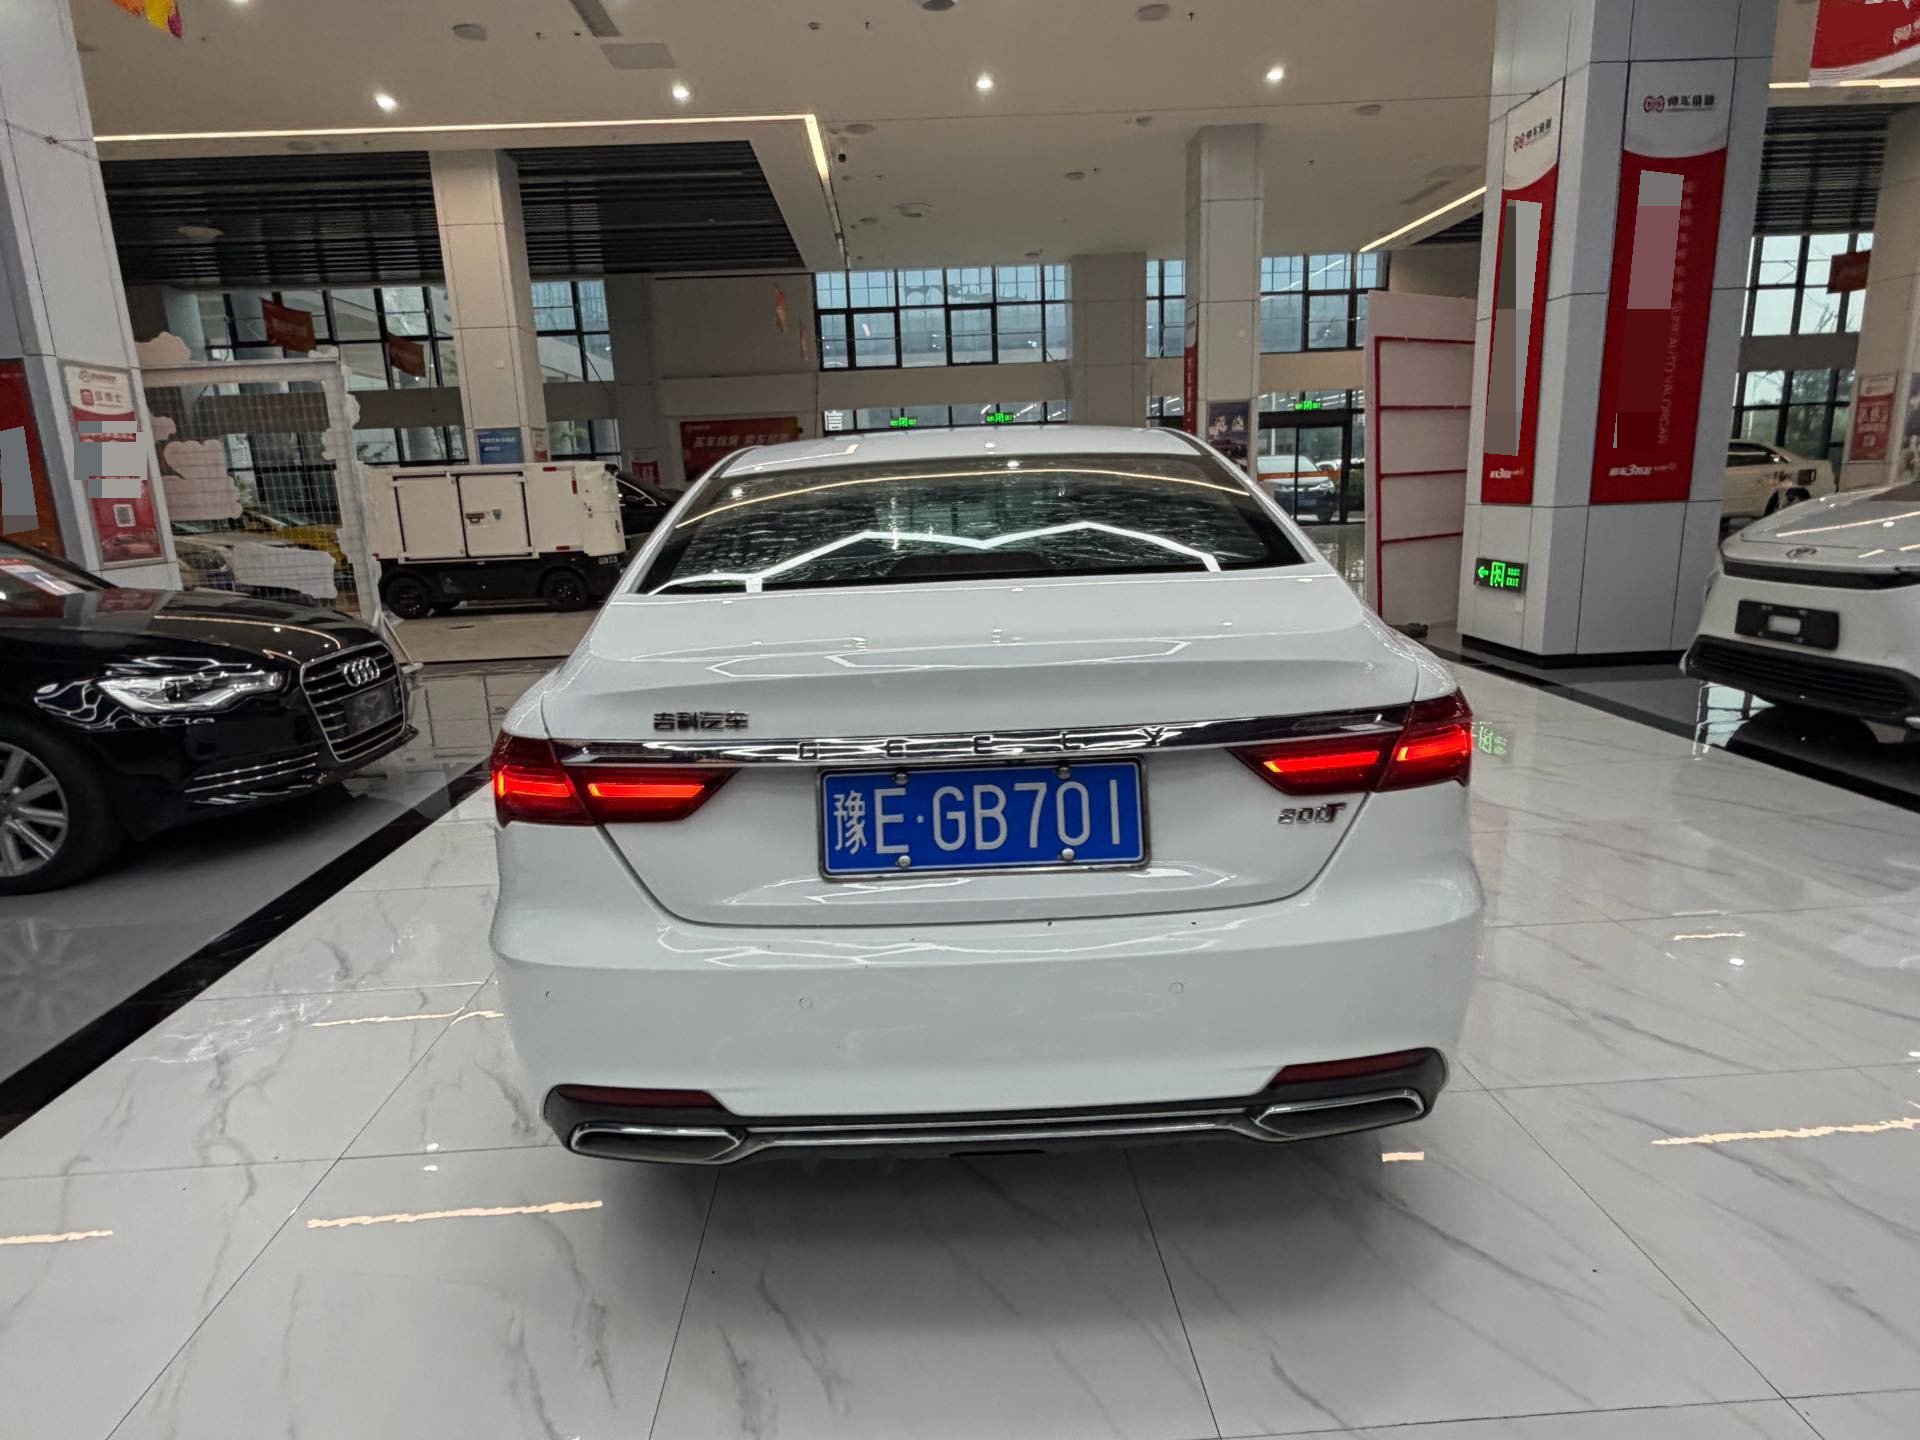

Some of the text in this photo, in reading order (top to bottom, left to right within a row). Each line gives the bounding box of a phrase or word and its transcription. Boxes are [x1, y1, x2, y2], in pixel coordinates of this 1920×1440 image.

[653, 711, 749, 731] 吉利汽车
[799, 726, 1165, 760] GEELY
